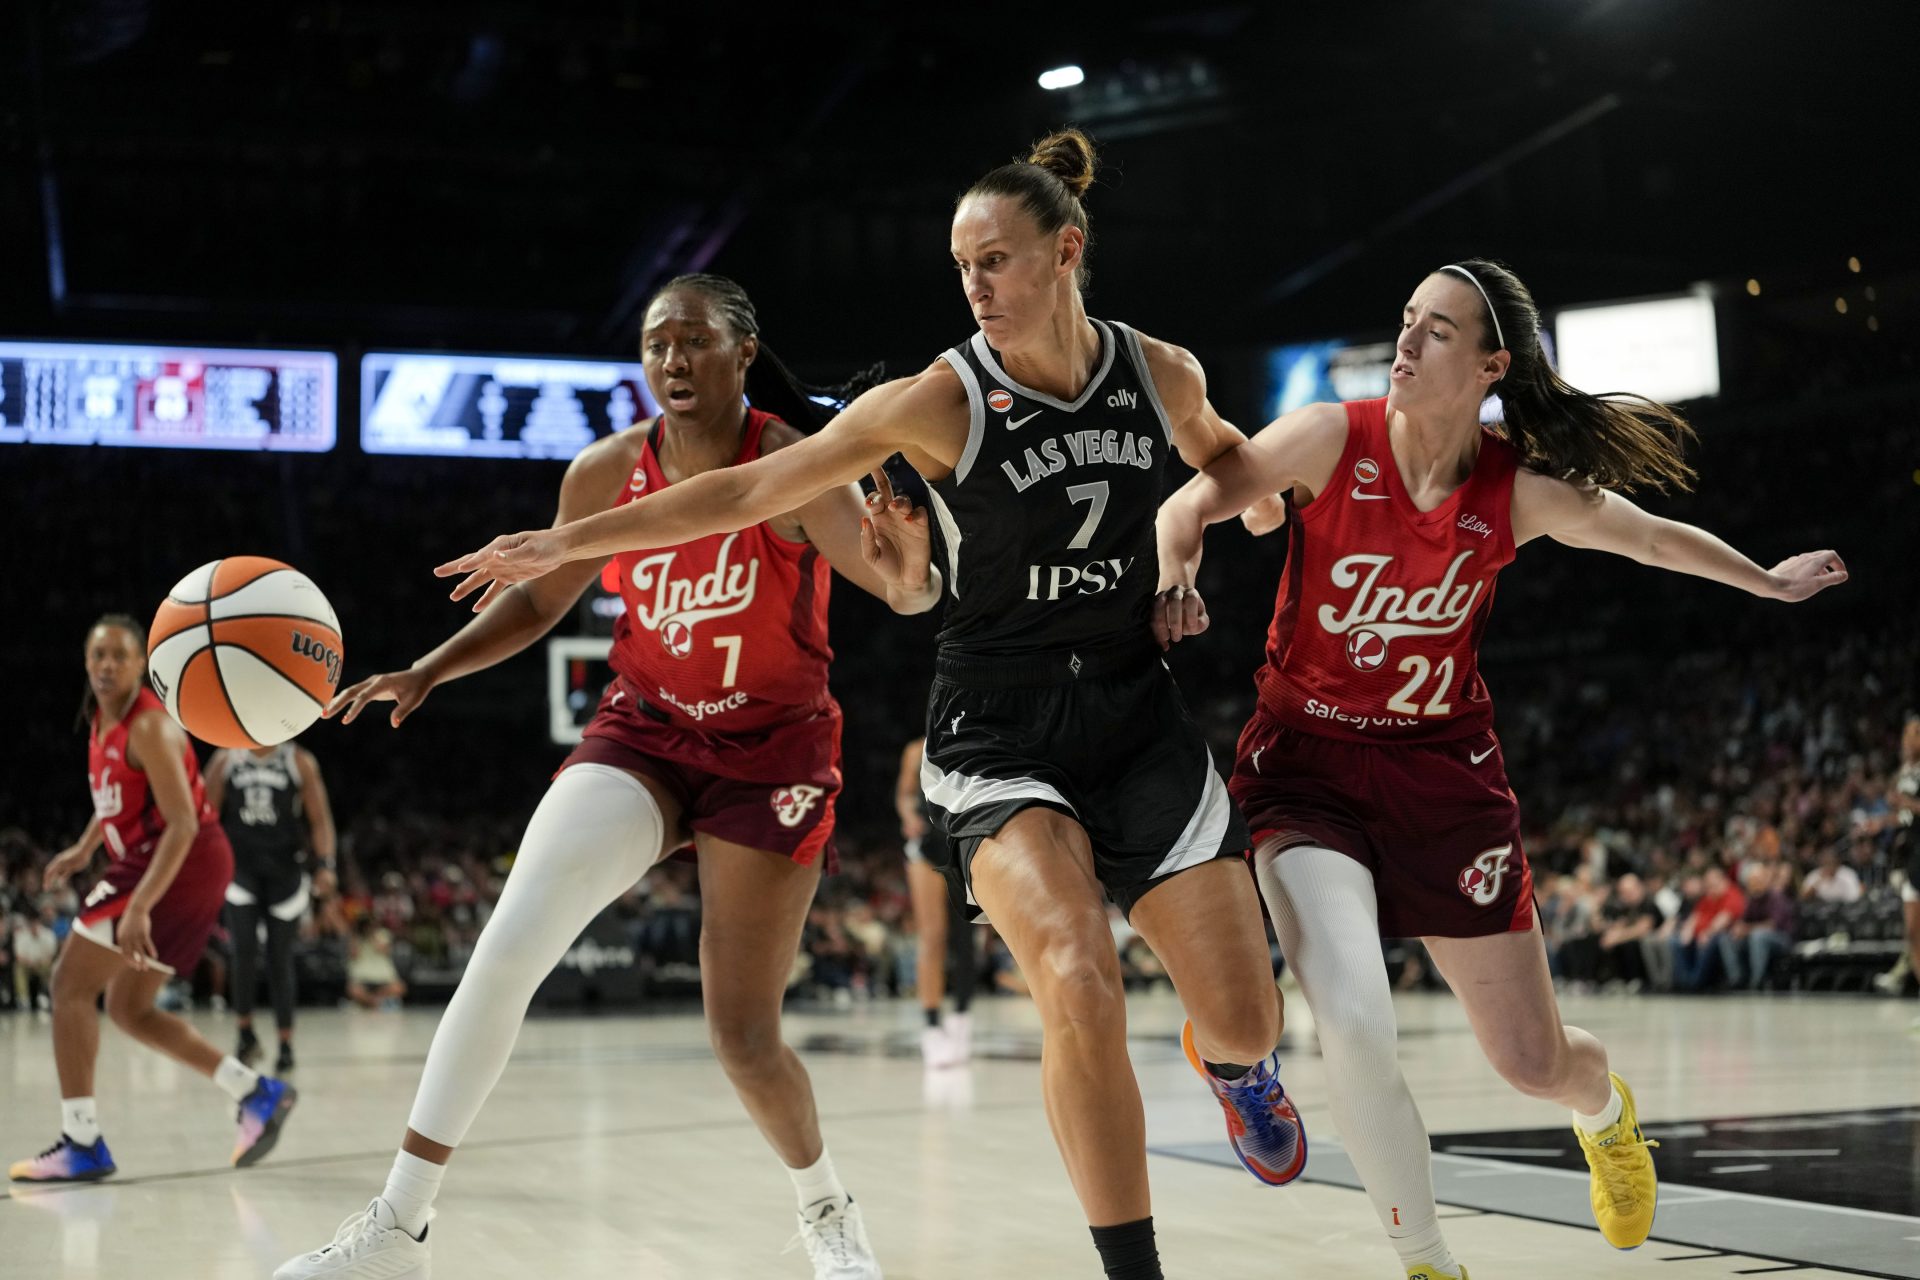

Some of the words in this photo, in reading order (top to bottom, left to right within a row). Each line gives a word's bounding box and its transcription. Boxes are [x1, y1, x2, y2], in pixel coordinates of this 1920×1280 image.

[1107, 389, 1138, 409] ally
[1000, 438, 1067, 493] LAS
[1063, 429, 1153, 470] VEGAS
[1066, 480, 1110, 550] 7
[1457, 513, 1493, 539] Lilly
[632, 532, 760, 631] Indy
[1026, 556, 1135, 601] IPSY
[1317, 550, 1484, 638] Indy
[291, 630, 343, 685] ilson
[713, 635, 743, 689] 7
[1386, 655, 1455, 716] 22
